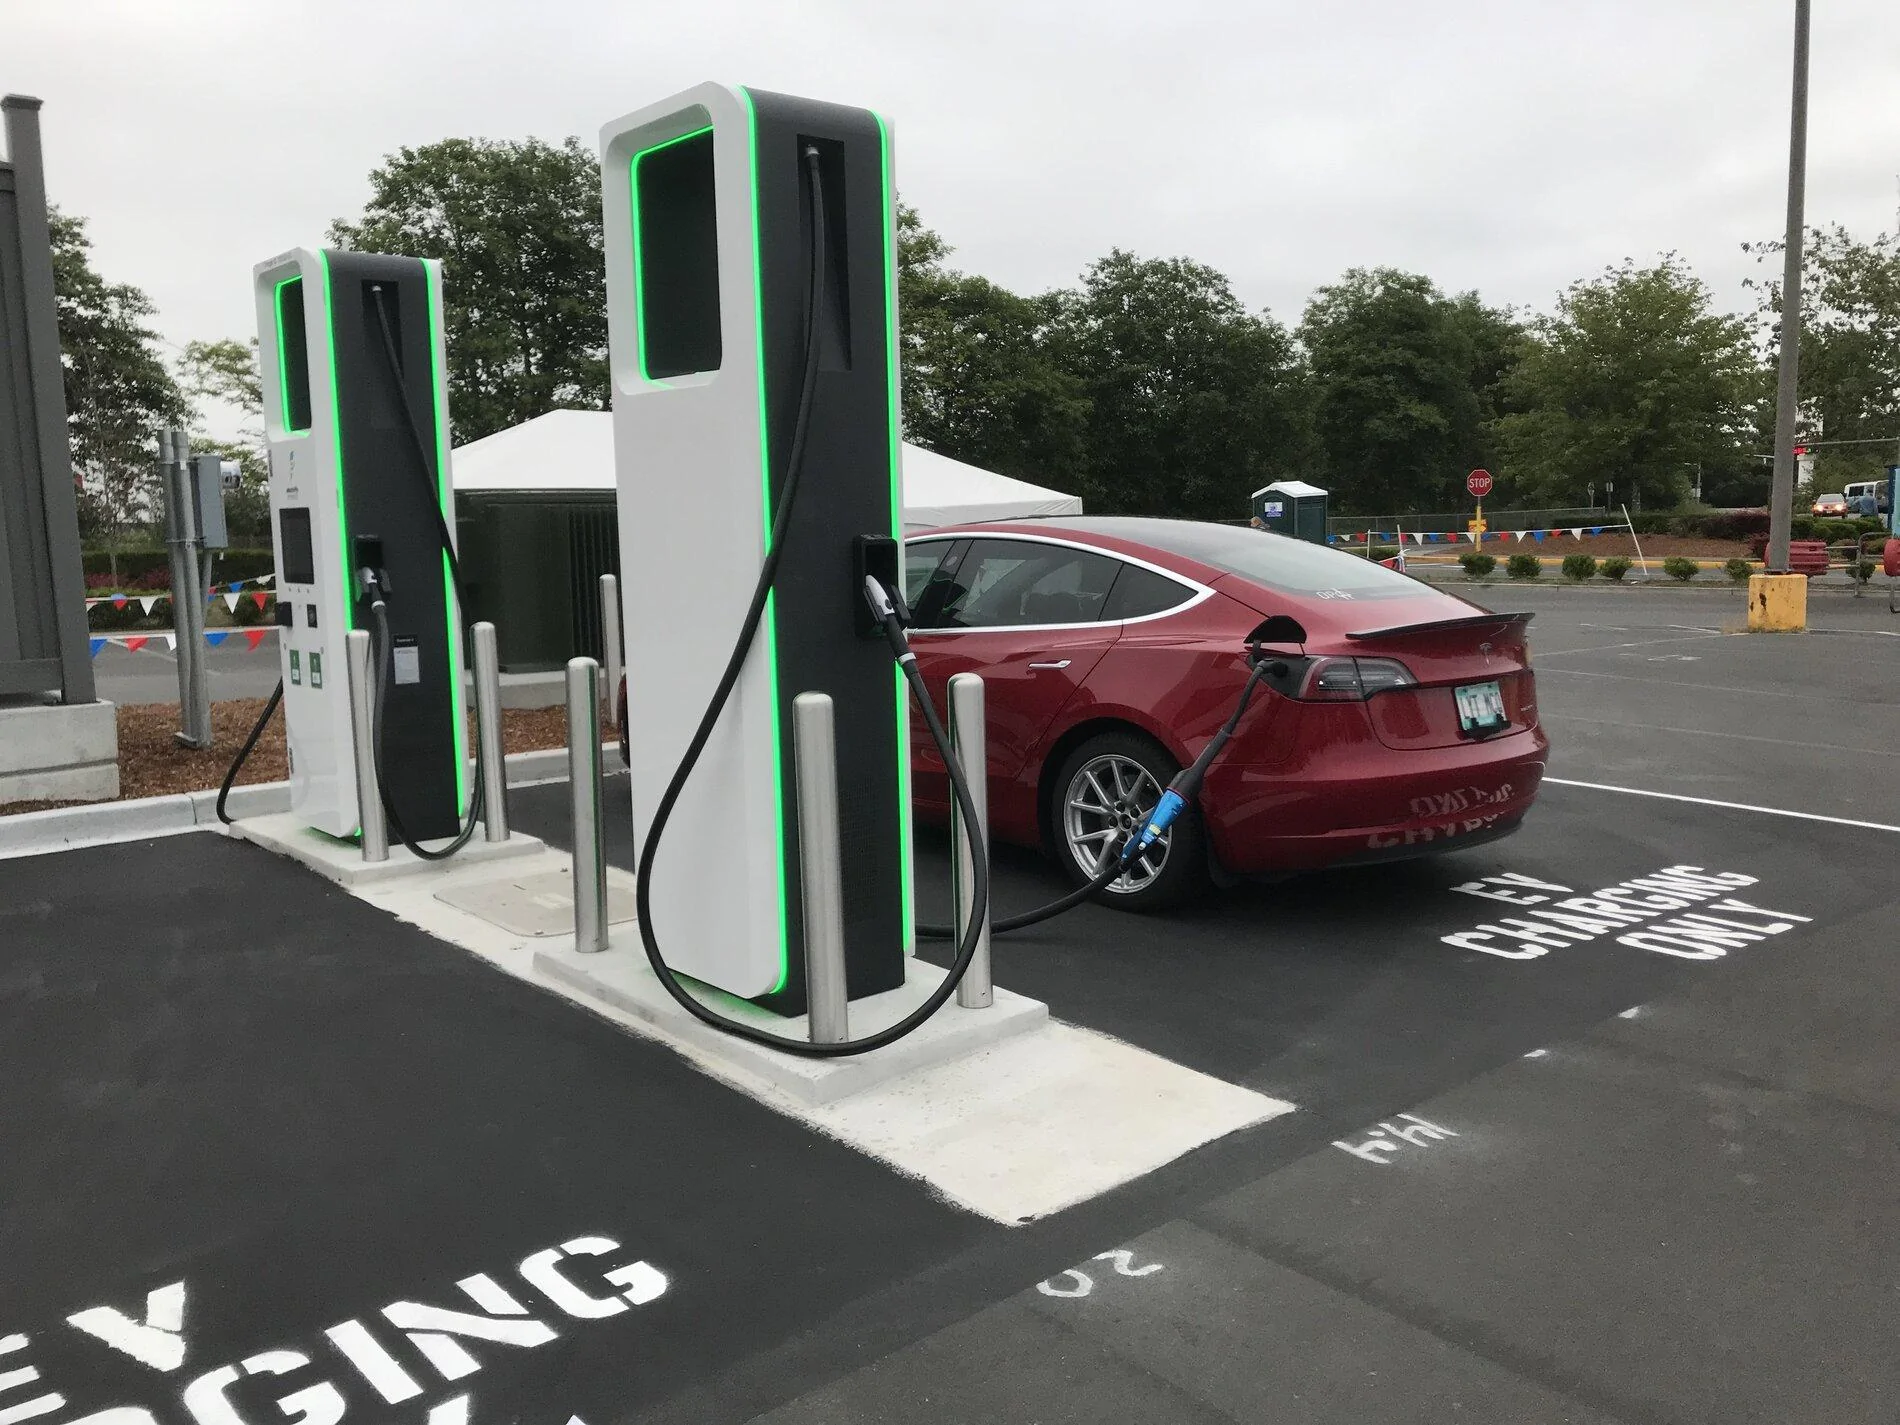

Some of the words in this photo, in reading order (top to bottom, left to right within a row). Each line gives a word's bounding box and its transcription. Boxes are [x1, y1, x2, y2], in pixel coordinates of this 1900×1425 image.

[1469, 477, 1491, 489] STOP
[1449, 872, 1574, 905] EV
[1440, 865, 1760, 960] CHARGING
[1616, 898, 1814, 960] ONLY
